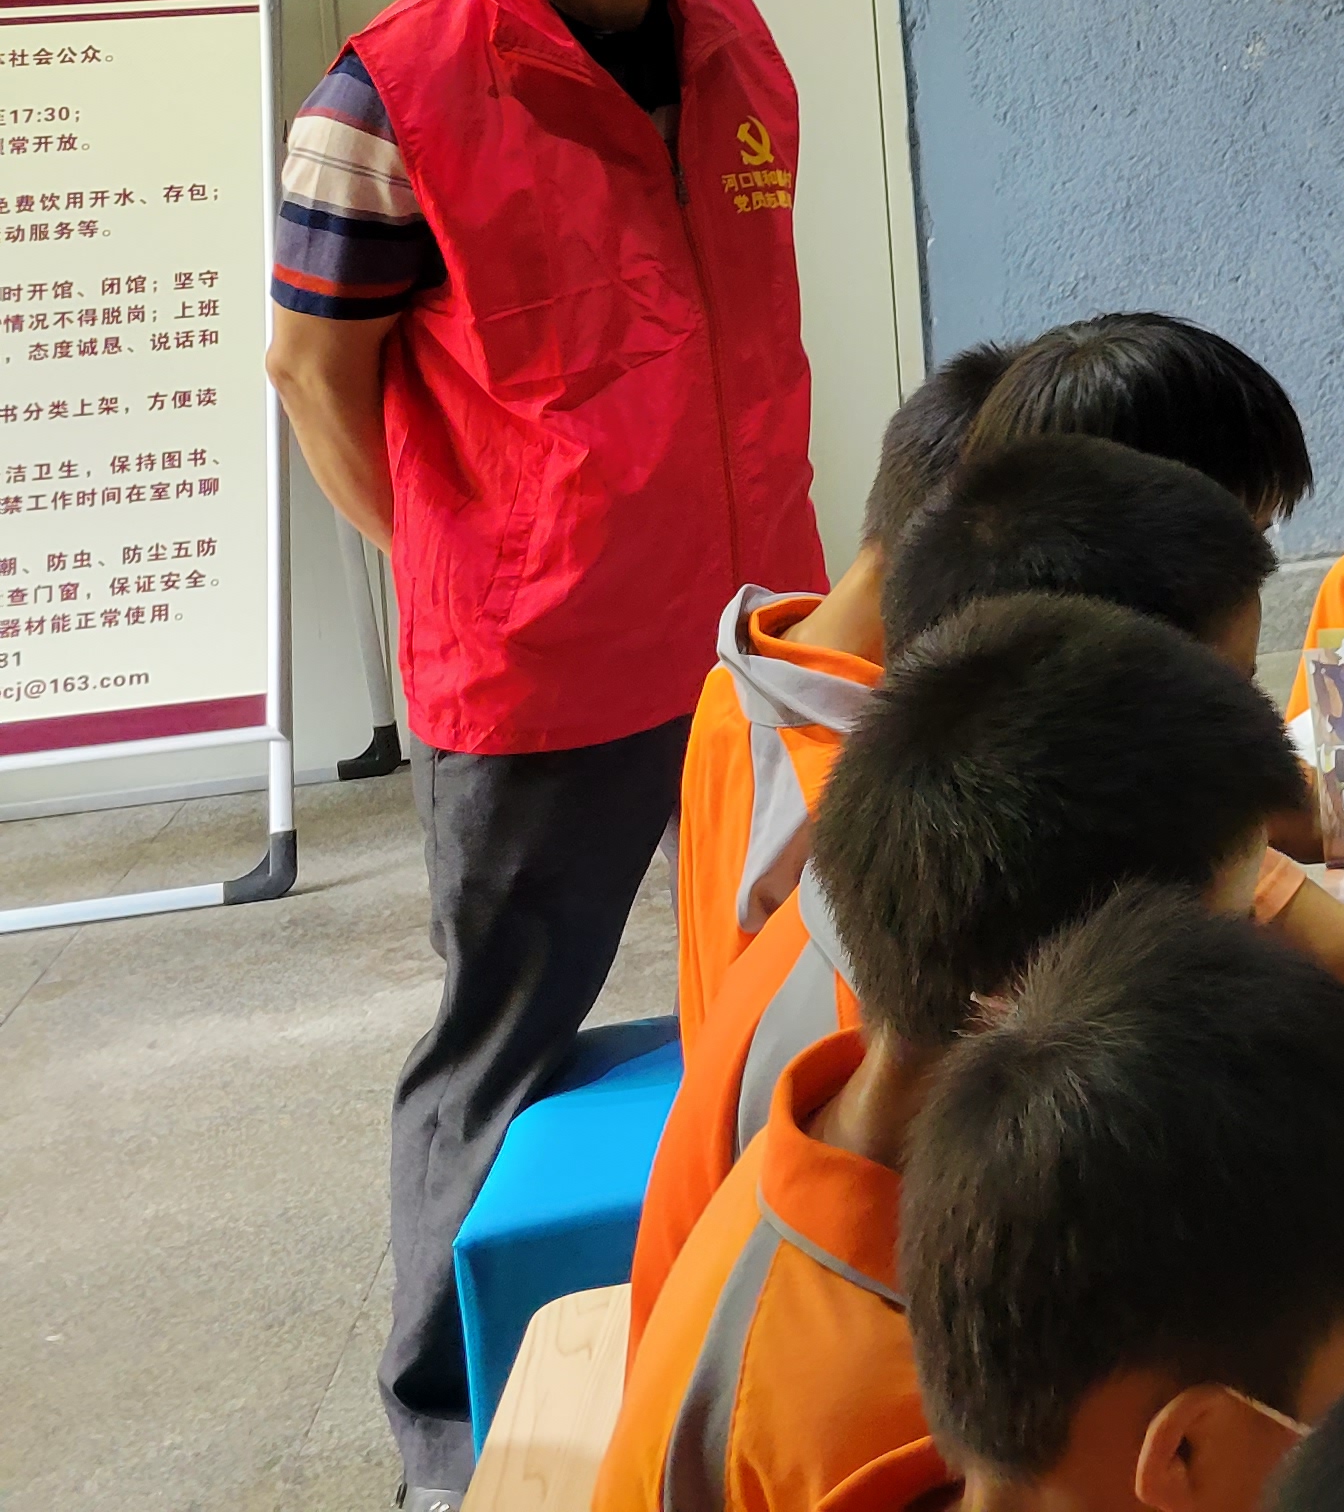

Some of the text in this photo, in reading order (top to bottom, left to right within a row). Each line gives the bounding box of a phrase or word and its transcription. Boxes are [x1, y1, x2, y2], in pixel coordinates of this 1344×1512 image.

[0, 44, 114, 68] 社会公众。
[0, 133, 91, 156] 常开放。
[0, 672, 151, 703] cj@163.com
